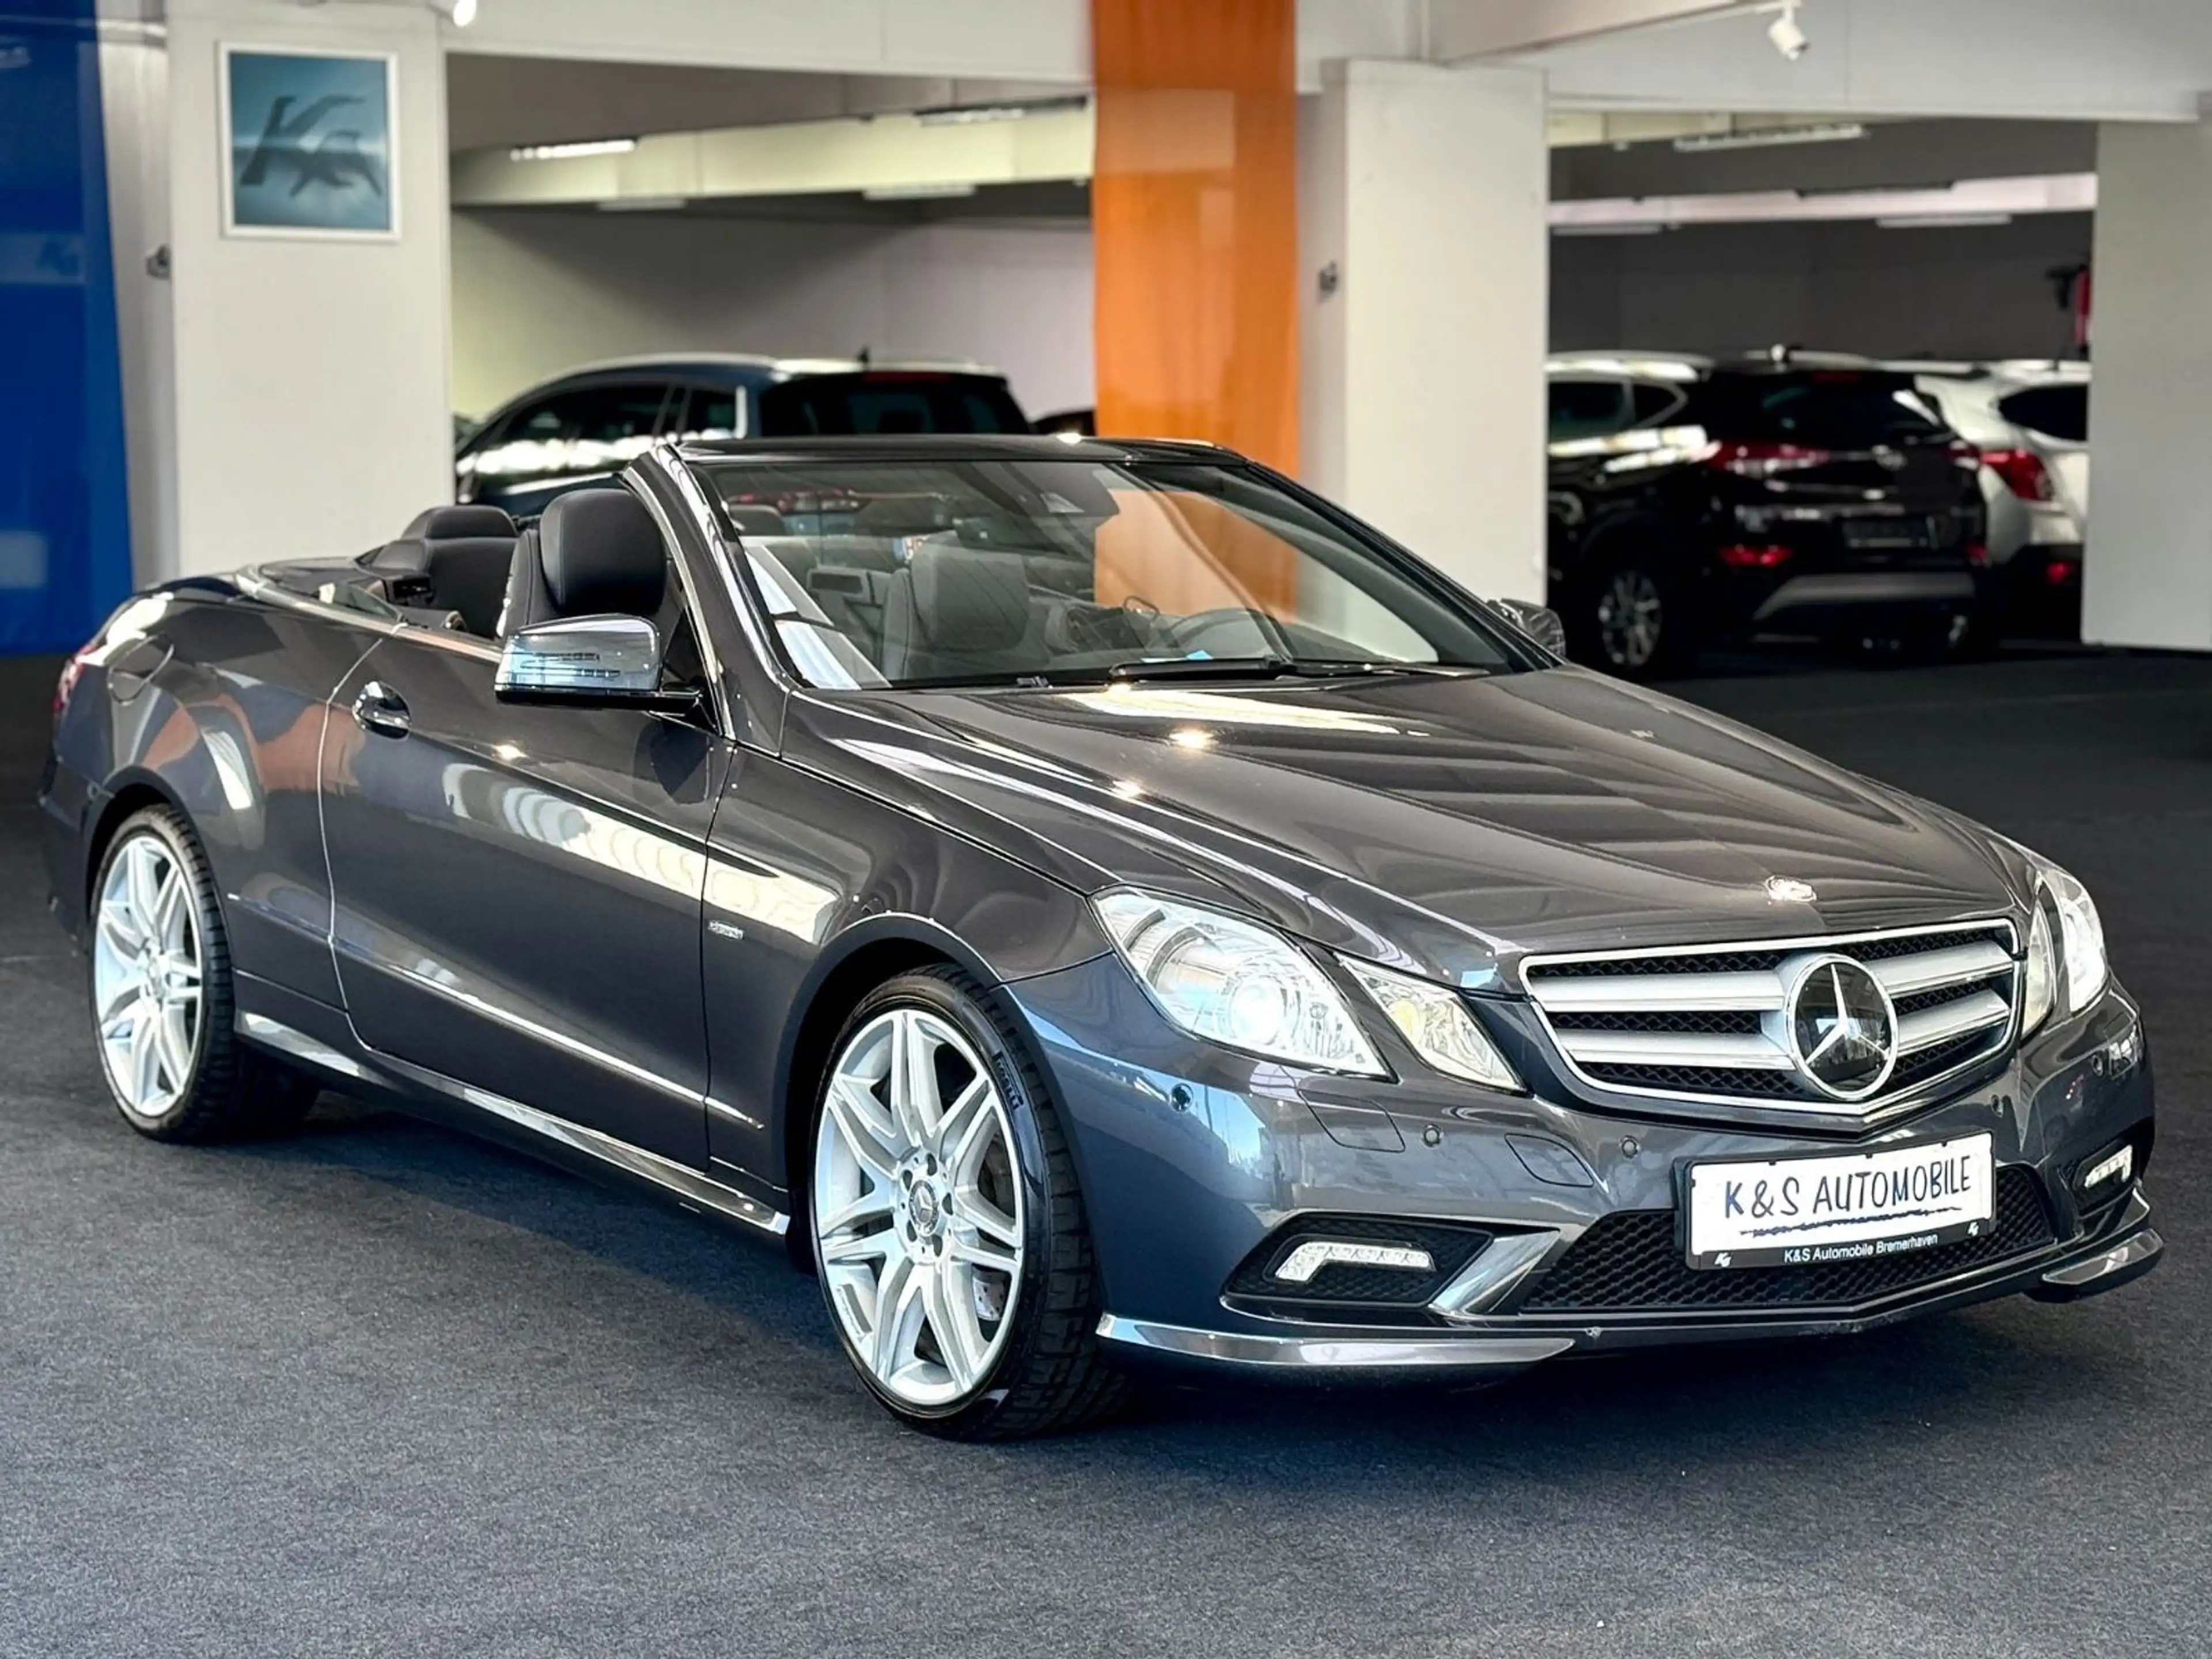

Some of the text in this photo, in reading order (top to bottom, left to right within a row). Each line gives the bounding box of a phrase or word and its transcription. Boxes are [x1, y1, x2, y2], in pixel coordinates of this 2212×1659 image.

[1812, 1155, 1971, 1214] AUTOMOBILE
[1784, 1233, 1938, 1262] K&S Automobile Bremerhaven
